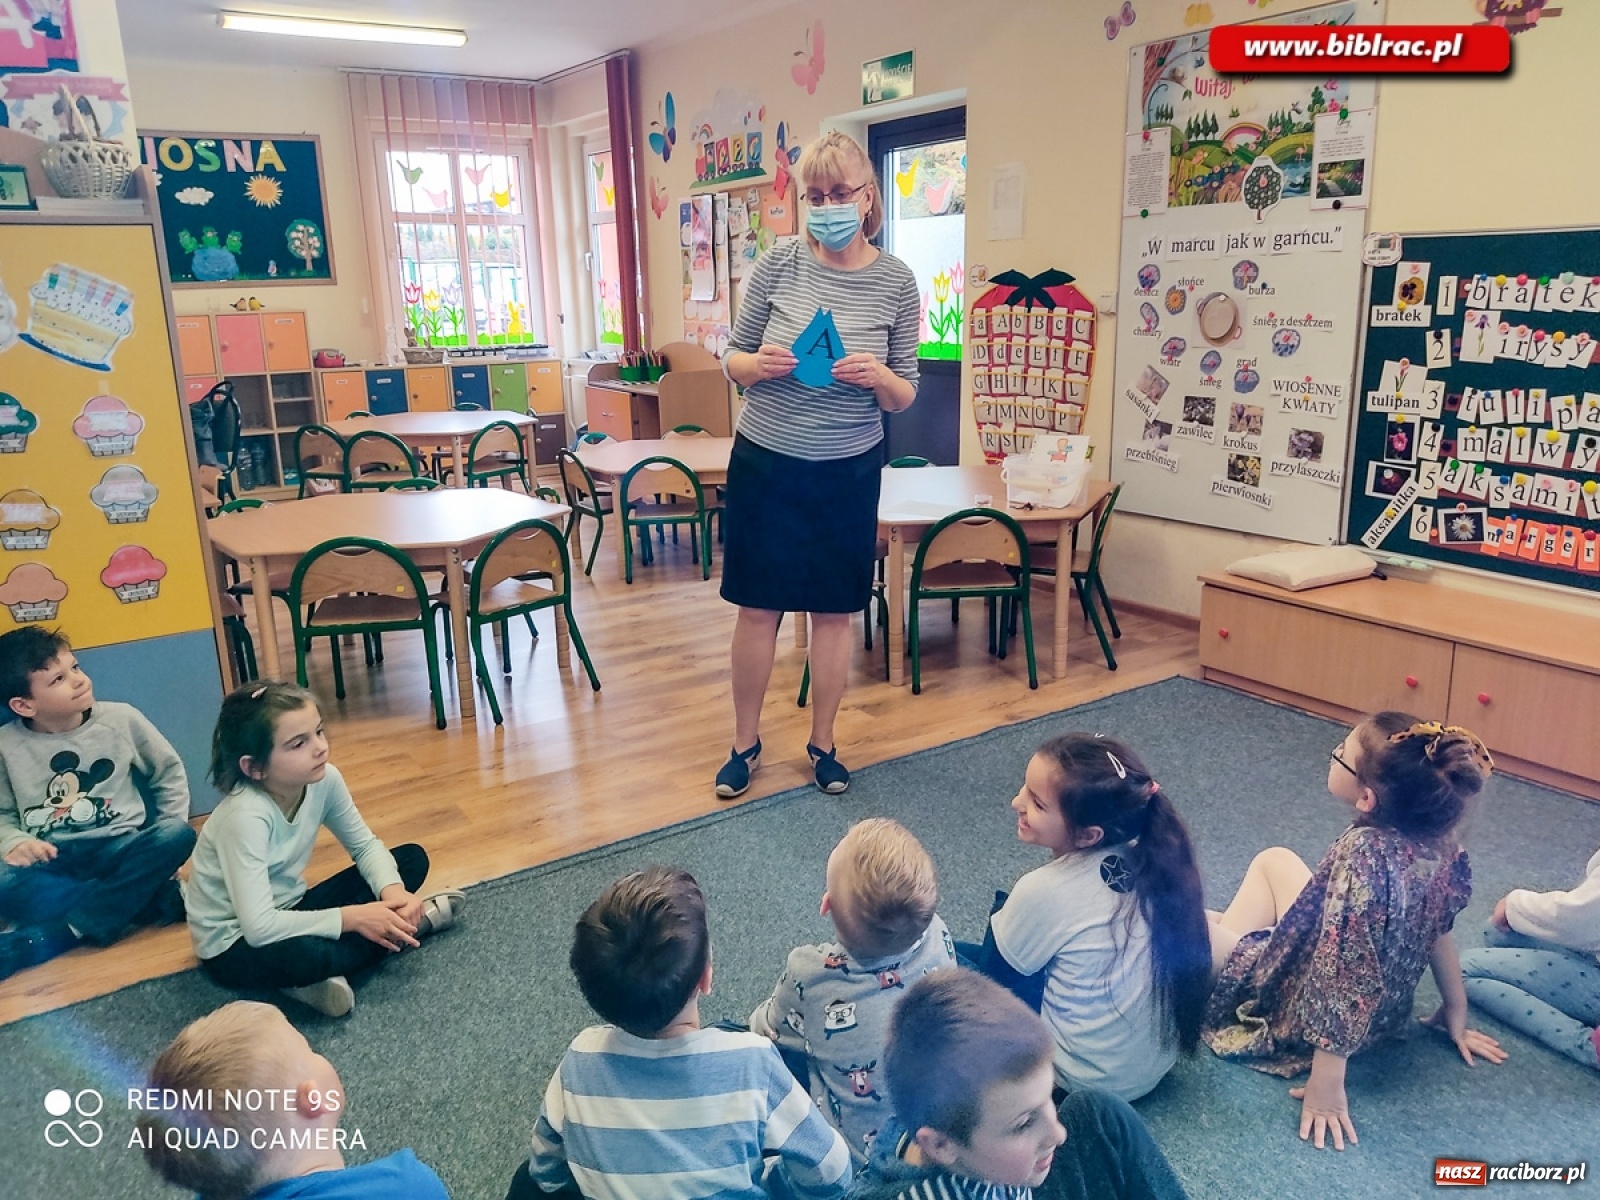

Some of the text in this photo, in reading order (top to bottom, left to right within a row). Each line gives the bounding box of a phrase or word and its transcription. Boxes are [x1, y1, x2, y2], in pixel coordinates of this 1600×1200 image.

[138, 136, 287, 173] IOSNA
[1142, 226, 1342, 257] „W marcu jak w garńcu.”
[1248, 285, 1275, 296] burza
[1472, 277, 1600, 309] bratek
[996, 314, 1008, 328] A
[1014, 315, 1022, 328] b
[1034, 315, 1044, 329] B
[1075, 318, 1086, 334] C
[1252, 315, 1333, 328] śnieg z deszczem
[1376, 308, 1422, 322] bratek
[805, 328, 837, 360] A
[1432, 332, 1592, 362] 2 irysy
[996, 344, 1004, 359] d
[1034, 346, 1042, 360] E
[1075, 351, 1085, 366] F
[1236, 357, 1258, 369] grad
[974, 374, 984, 389] G
[994, 374, 1004, 389] H
[1048, 379, 1058, 393] K
[1070, 381, 1080, 396] L
[1199, 376, 1222, 389] śnieg
[1272, 379, 1342, 398] WIOSENNE
[1125, 388, 1155, 419] sasanki
[1282, 396, 1336, 415] KWIATY
[1371, 394, 1420, 410] tulipan
[1427, 390, 1438, 410] 3
[1000, 404, 1012, 419] M
[1019, 405, 1029, 419] N
[1059, 410, 1067, 426] P
[986, 431, 995, 447] R
[1176, 425, 1214, 440] zawilec
[1222, 435, 1259, 451] krokus
[1125, 447, 1177, 473] przebiśnieg
[1424, 432, 1598, 469] 4 malwy
[1270, 460, 1341, 484] przylaszczki
[1423, 471, 1437, 490] 5
[1211, 479, 1273, 507] pierwiosnki
[1415, 514, 1595, 558] 6 marger
